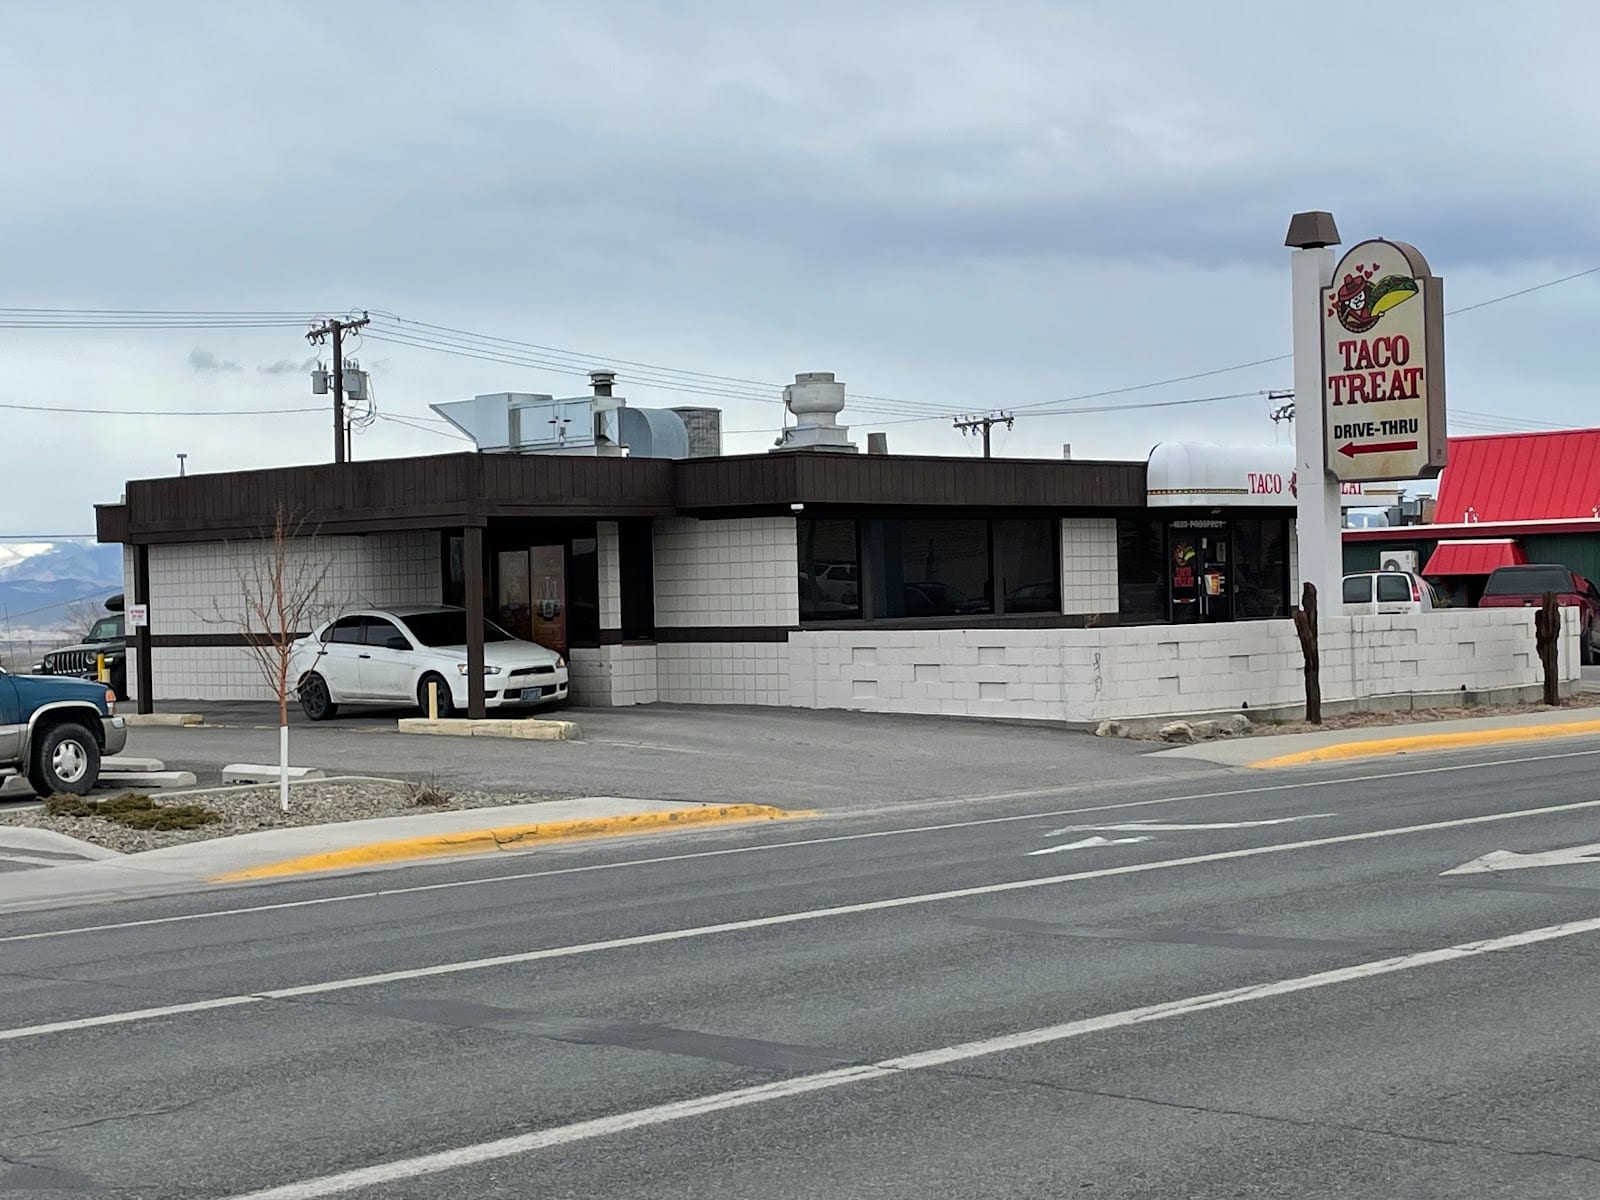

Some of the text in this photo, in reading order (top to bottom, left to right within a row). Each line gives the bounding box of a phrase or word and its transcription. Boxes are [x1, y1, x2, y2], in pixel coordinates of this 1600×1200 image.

[1338, 335, 1410, 371] TACO
[1328, 367, 1424, 406] TREAT
[1334, 418, 1418, 439] DRIVE-THRU
[1248, 473, 1282, 494] TACO
